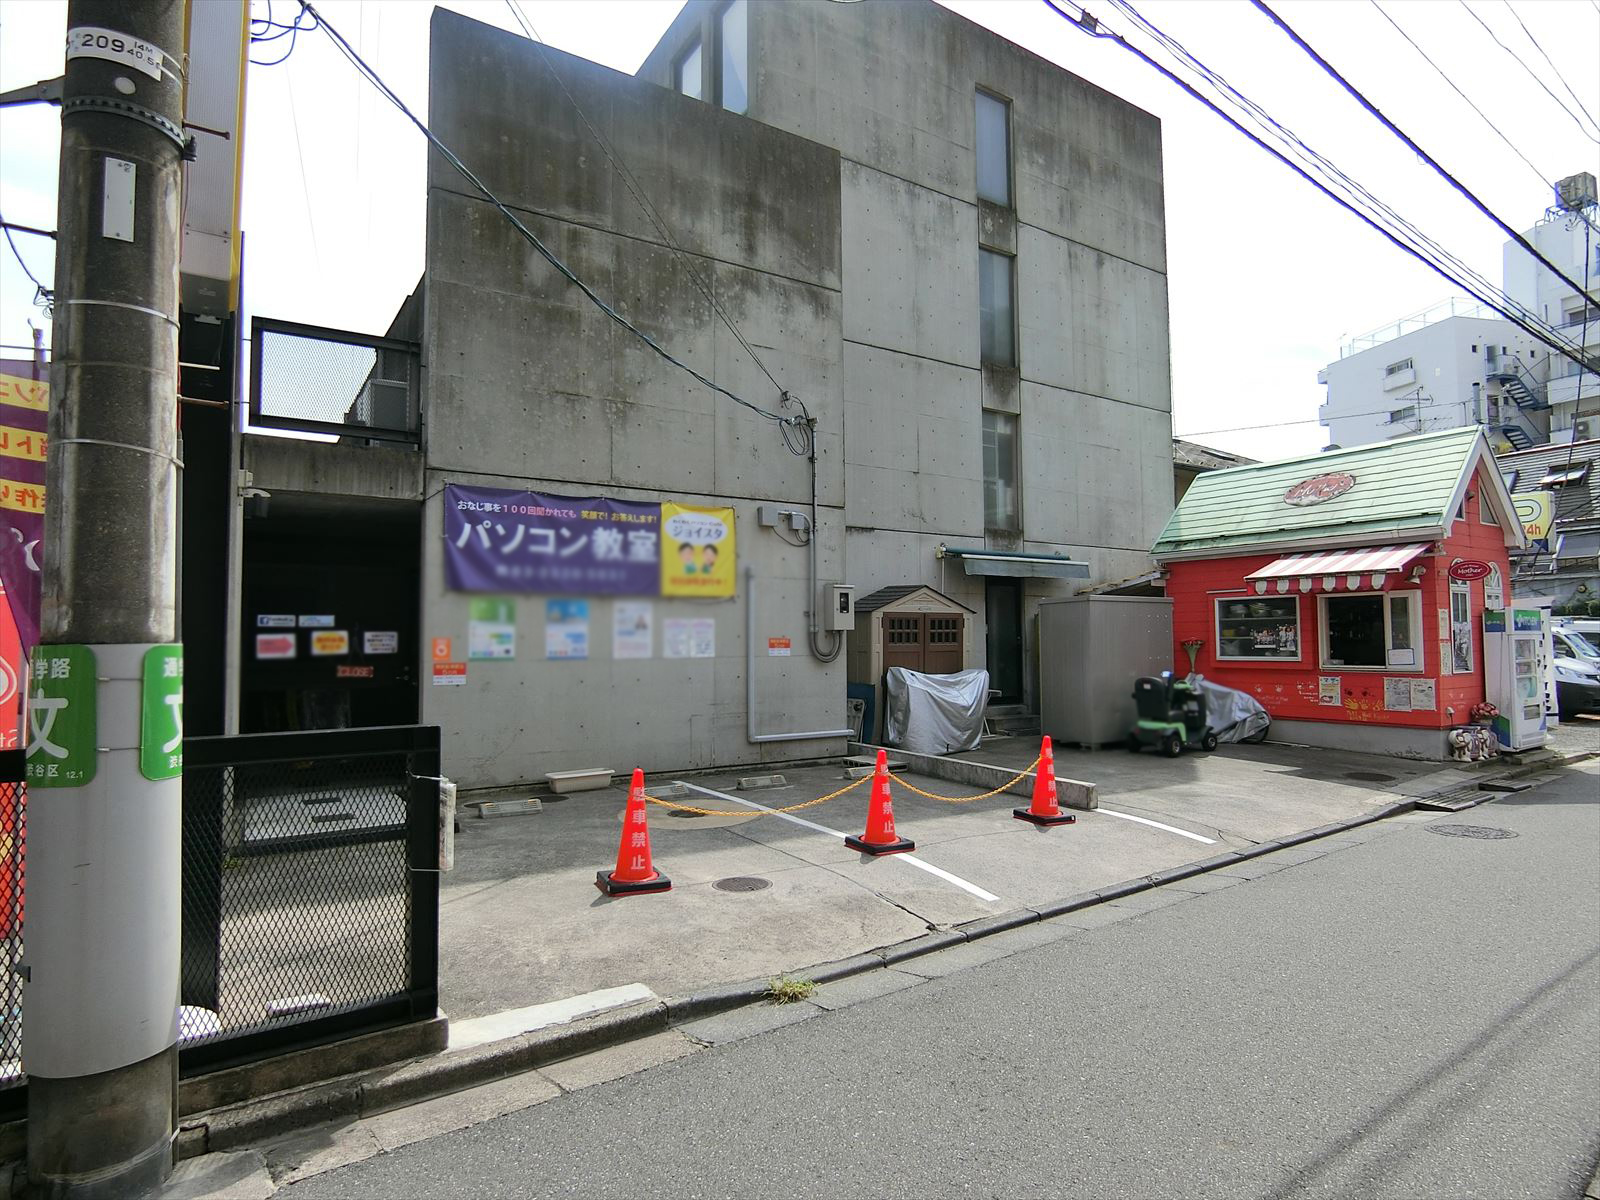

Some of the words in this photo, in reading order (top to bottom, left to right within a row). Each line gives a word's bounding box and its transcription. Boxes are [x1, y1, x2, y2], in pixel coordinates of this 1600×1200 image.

[81, 33, 125, 53] 209
[673, 525, 723, 540] ジョイスタ
[455, 520, 658, 562] パソコン教室
[340, 667, 370, 677] CLOSE
[66, 771, 84, 779] 12.1
